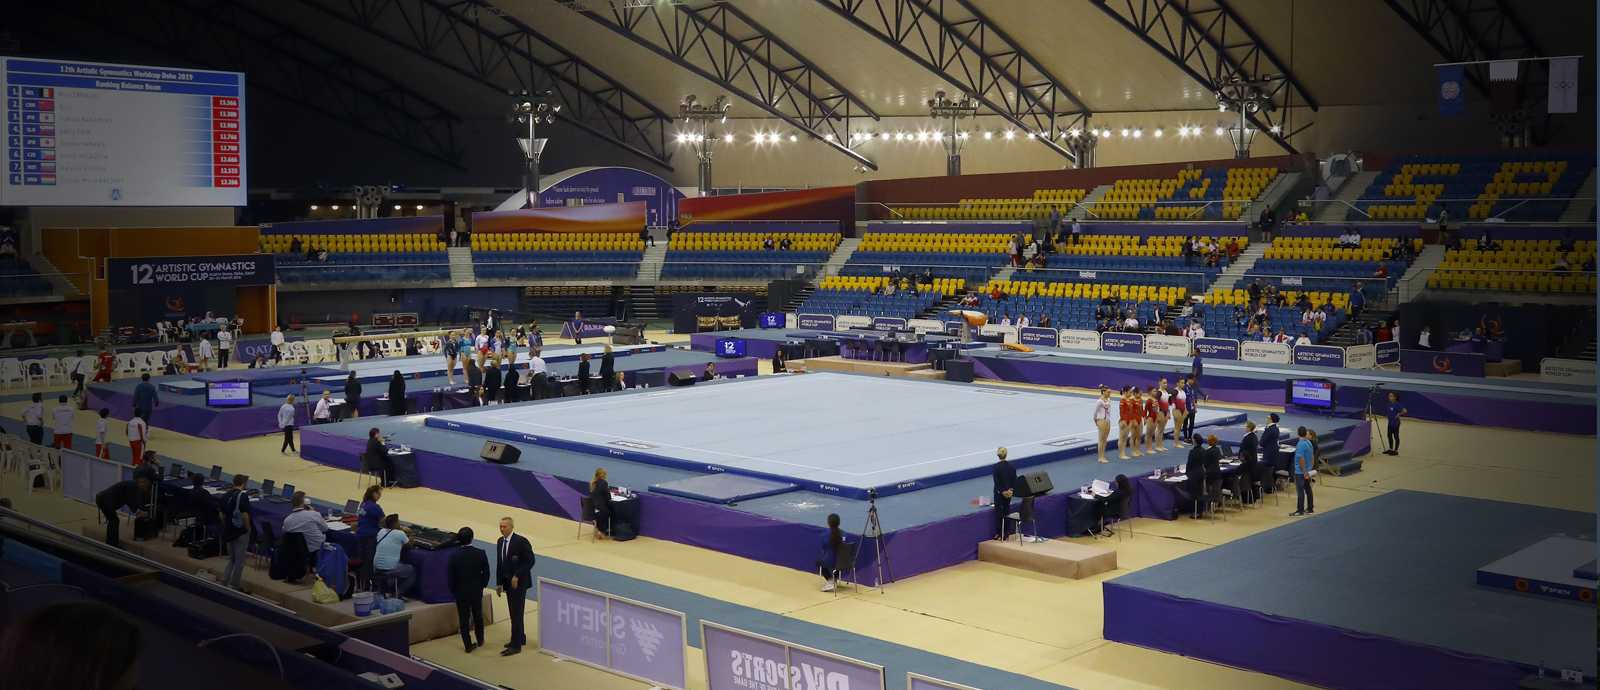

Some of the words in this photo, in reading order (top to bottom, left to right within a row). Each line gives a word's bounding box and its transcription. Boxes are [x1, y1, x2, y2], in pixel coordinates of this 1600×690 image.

[76, 67, 98, 75] Artistic
[100, 68, 133, 77] Gymnastics
[133, 70, 161, 80] Worldcup
[96, 80, 120, 90] Ranking
[130, 264, 154, 284] 12
[156, 264, 196, 273] ARTISTIC
[198, 262, 255, 272] GYMNASTICS
[156, 274, 188, 282] WORLD
[190, 272, 208, 281] CUP
[246, 345, 272, 356] QATA
[1548, 587, 1570, 596] SPIETH
